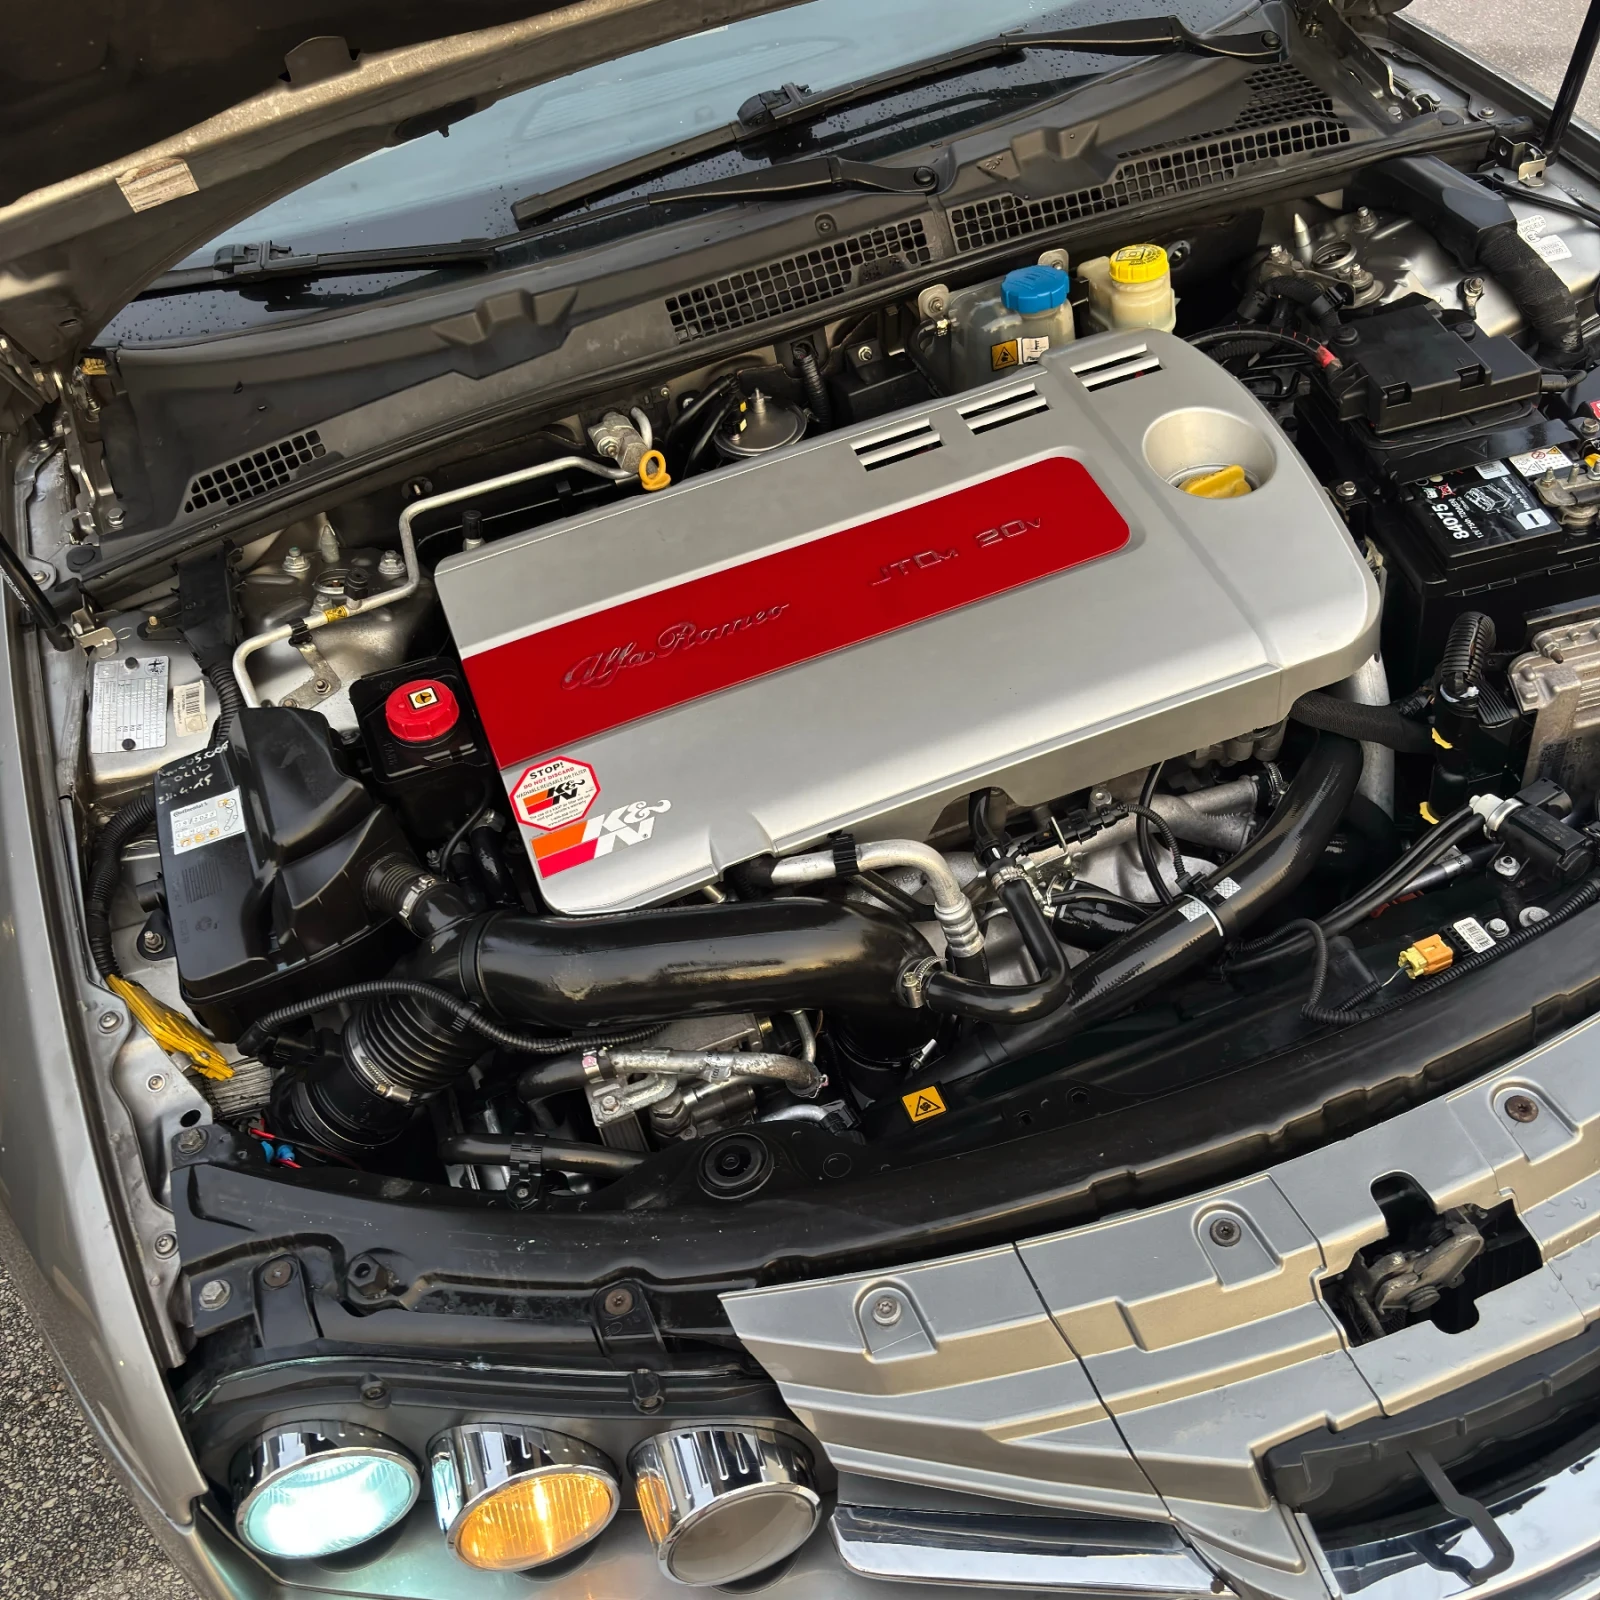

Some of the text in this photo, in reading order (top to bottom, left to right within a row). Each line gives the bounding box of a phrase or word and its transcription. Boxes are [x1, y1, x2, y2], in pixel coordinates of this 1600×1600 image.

[1432, 503, 1470, 540] 84075
[561, 603, 790, 691] Alfa Romeo
[529, 761, 565, 780] STOP!
[533, 778, 546, 786] NOT
[547, 766, 575, 780] DISCARD
[572, 768, 587, 778] FILTER
[582, 799, 672, 860] K&N
